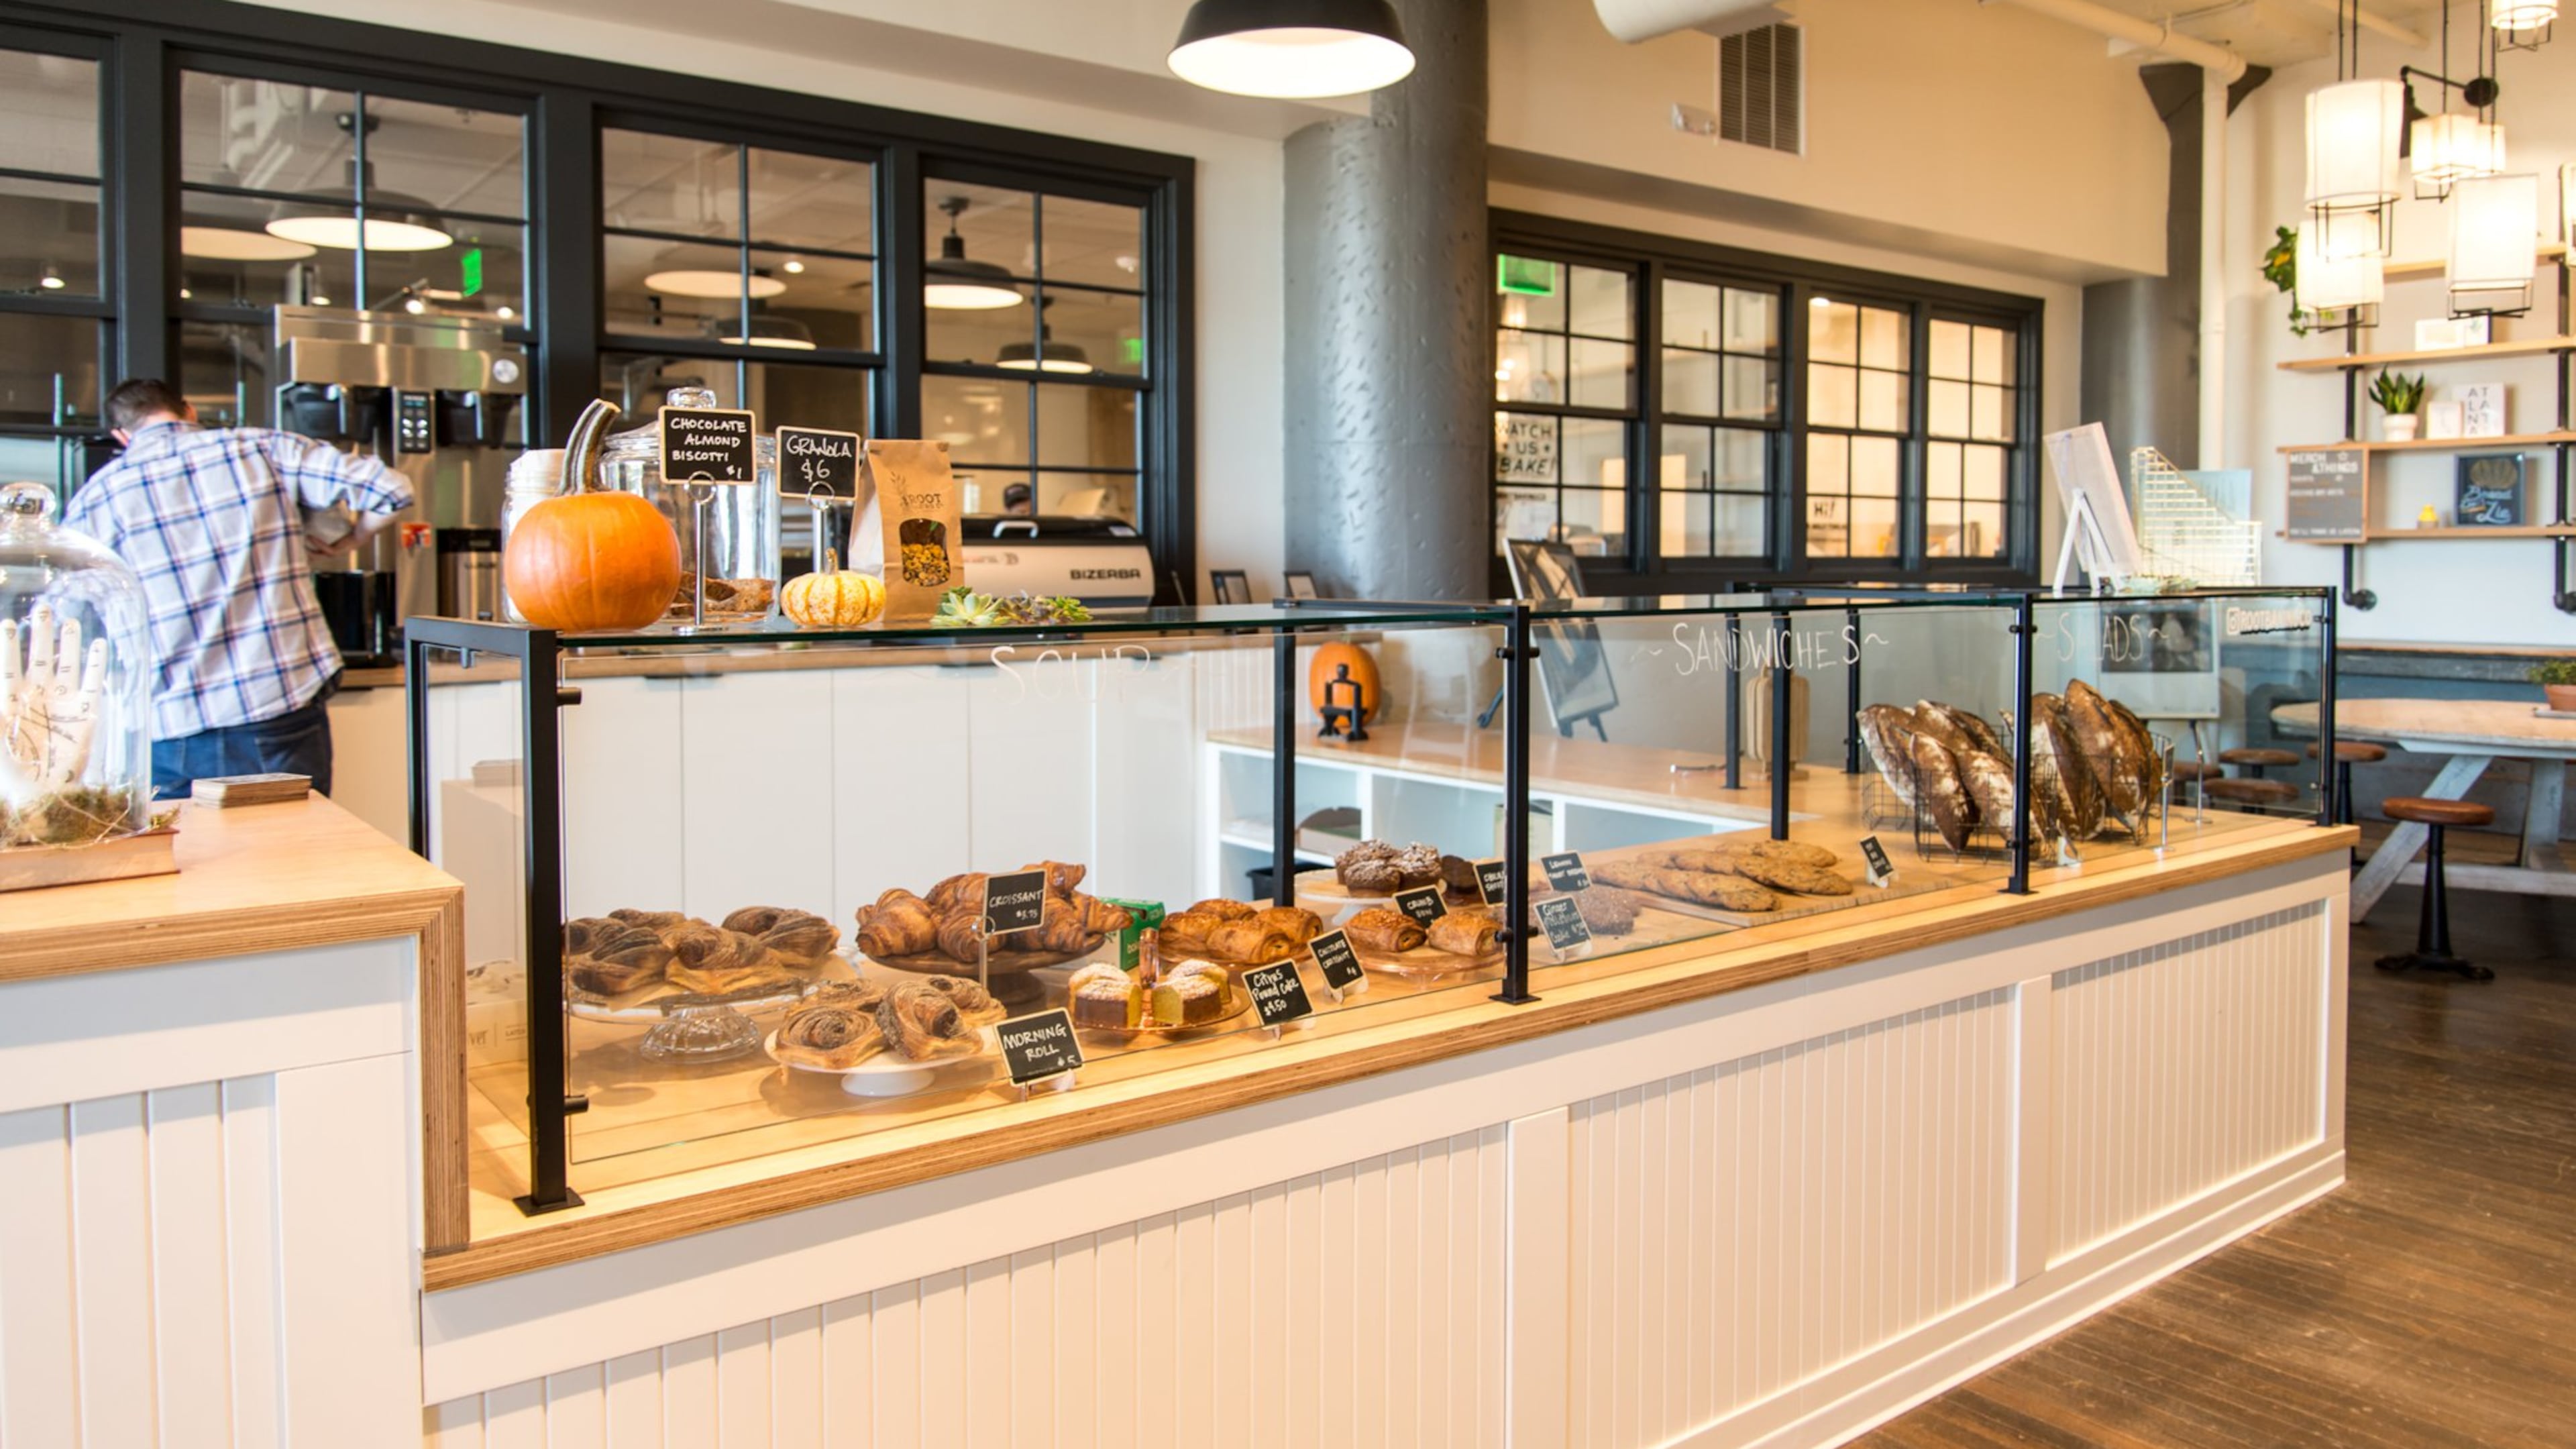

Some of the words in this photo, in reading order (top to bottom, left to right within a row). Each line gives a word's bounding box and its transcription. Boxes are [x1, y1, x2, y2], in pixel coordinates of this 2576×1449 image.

[670, 417, 747, 433] CHOCOLATE
[684, 433, 741, 448] ALMOND
[786, 435, 853, 459] GRANOLA
[1515, 441, 1538, 455] US
[672, 450, 729, 462] BISCOTTI
[726, 464, 743, 480] $1
[800, 458, 830, 482] $6
[1070, 569, 1141, 580] BIZERBA
[2057, 611, 2143, 663] SADS
[1672, 622, 1860, 676] SANDWICHES
[990, 645, 1151, 706] SOUP
[989, 889, 1044, 908] CROISSANT
[1252, 981, 1281, 1001] Pound
[1279, 977, 1300, 995] Cake
[1003, 1023, 1067, 1051] MORNING
[1024, 1043, 1061, 1063] ROLL
